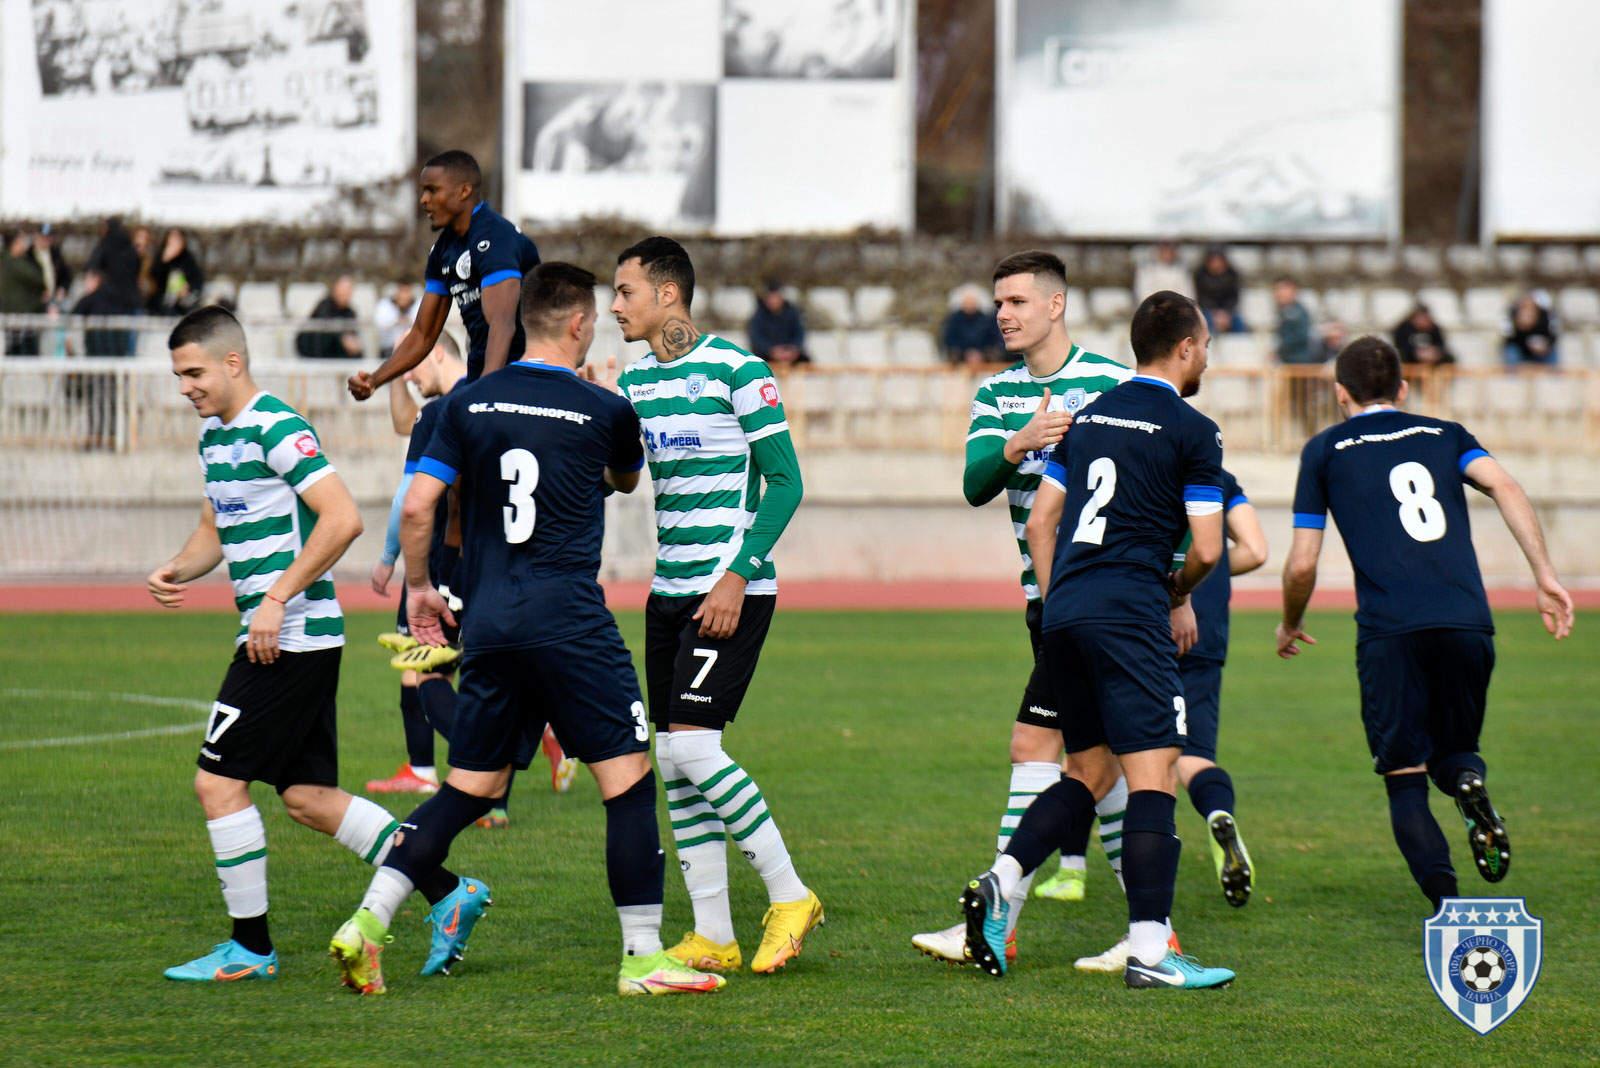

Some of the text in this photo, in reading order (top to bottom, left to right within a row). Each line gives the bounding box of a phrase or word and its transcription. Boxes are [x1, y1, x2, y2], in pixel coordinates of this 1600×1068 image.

[500, 448, 539, 544] 3
[1071, 457, 1117, 546] 2
[1389, 461, 1447, 543] 8
[689, 648, 718, 689] 7
[680, 692, 713, 704] uhlsport
[1029, 705, 1058, 718] uhlspor
[1172, 695, 1188, 736] 2
[630, 700, 650, 742] 3
